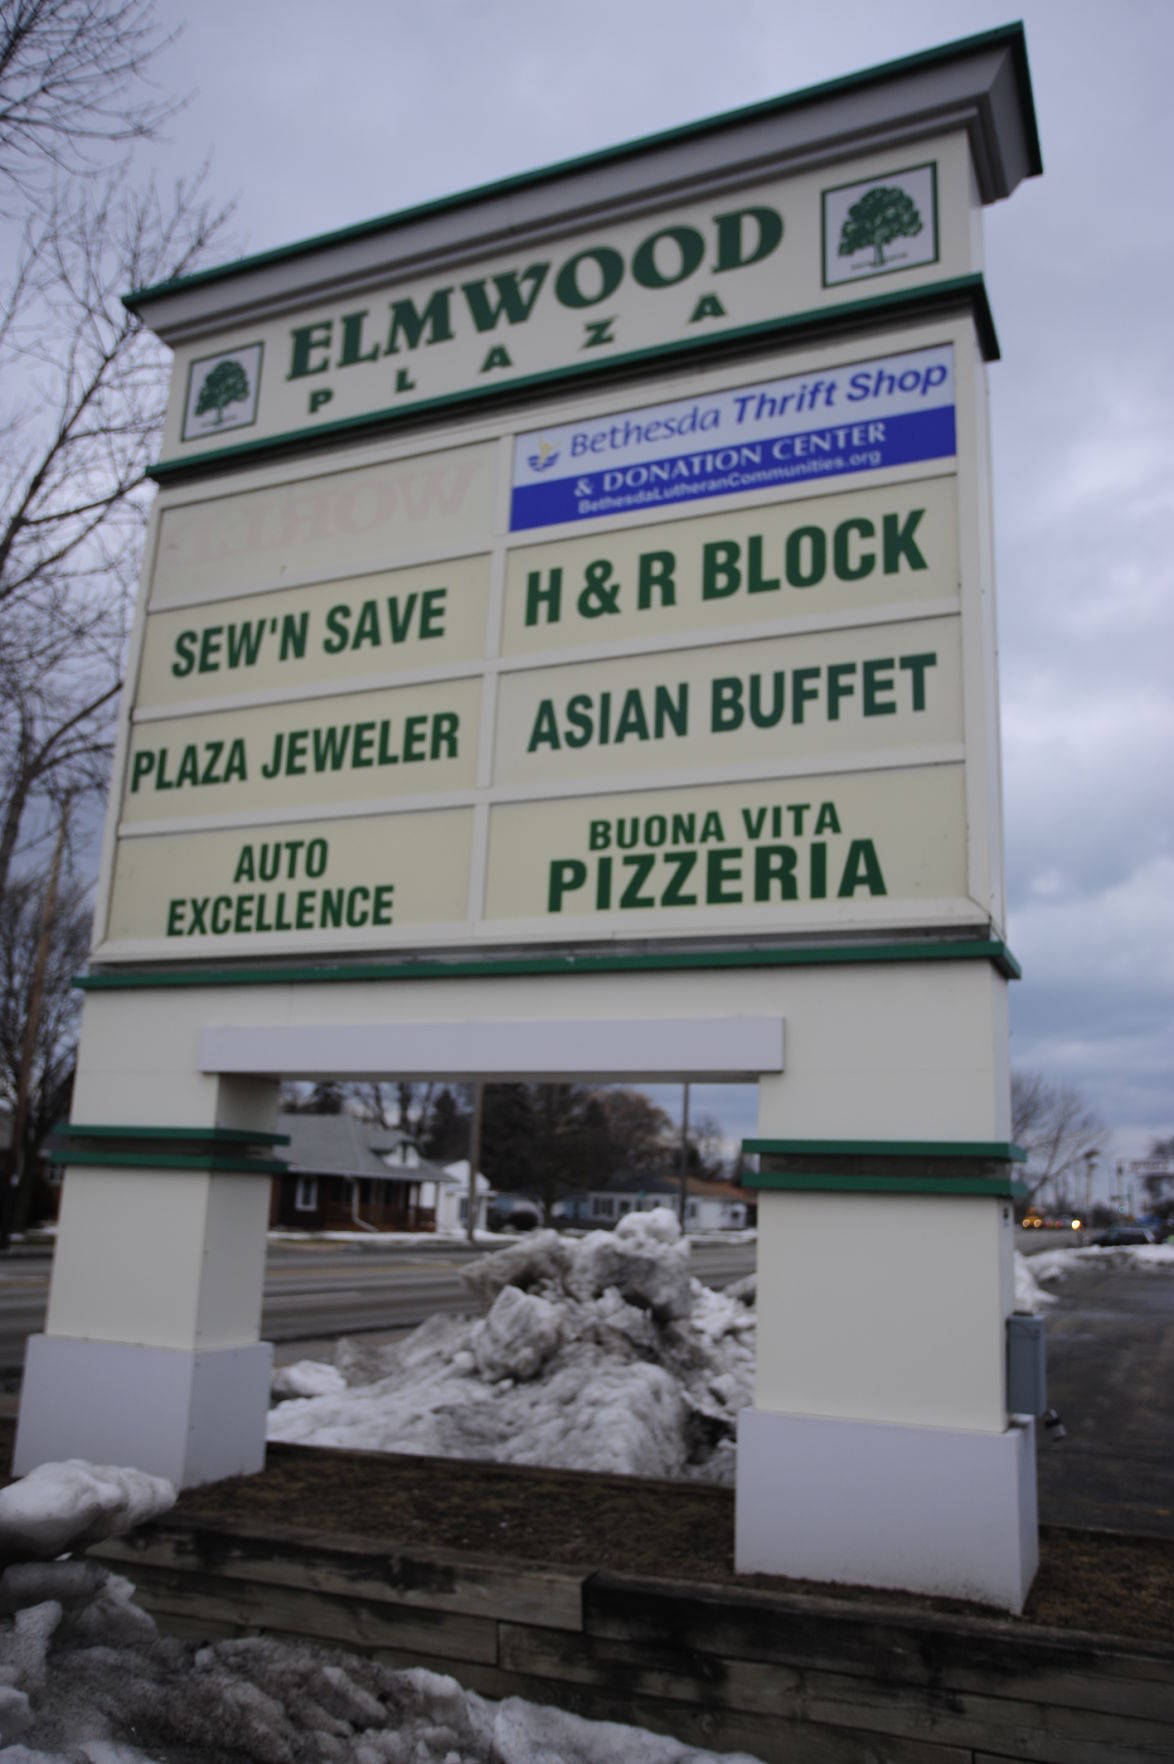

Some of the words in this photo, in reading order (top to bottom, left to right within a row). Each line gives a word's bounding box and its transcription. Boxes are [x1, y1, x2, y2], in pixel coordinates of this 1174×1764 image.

[285, 205, 785, 382] ELMWOOD
[570, 406, 721, 457] Bethesda
[732, 382, 838, 424] Thrift
[846, 364, 948, 402] Shop
[573, 477, 593, 499] &
[603, 446, 762, 492] DONATION
[772, 422, 887, 461] CENTER
[578, 449, 882, 514] BethesdaLutheranCommunities.org
[524, 567, 563, 627] H
[577, 559, 621, 619] &
[637, 550, 677, 611] R
[702, 508, 929, 601] BLOCK
[171, 611, 310, 679] SEW'N
[322, 588, 448, 655] SAVE
[527, 682, 689, 753] ASIAN
[711, 652, 937, 734] BUFFET
[130, 738, 248, 793] PLAZA
[261, 711, 460, 780] JEWELER
[232, 837, 329, 884] AUTO
[588, 810, 725, 852] BUONA
[741, 801, 842, 840] VITA
[165, 884, 395, 938] EXCELLENCE
[547, 838, 888, 914] PIZZERIA
